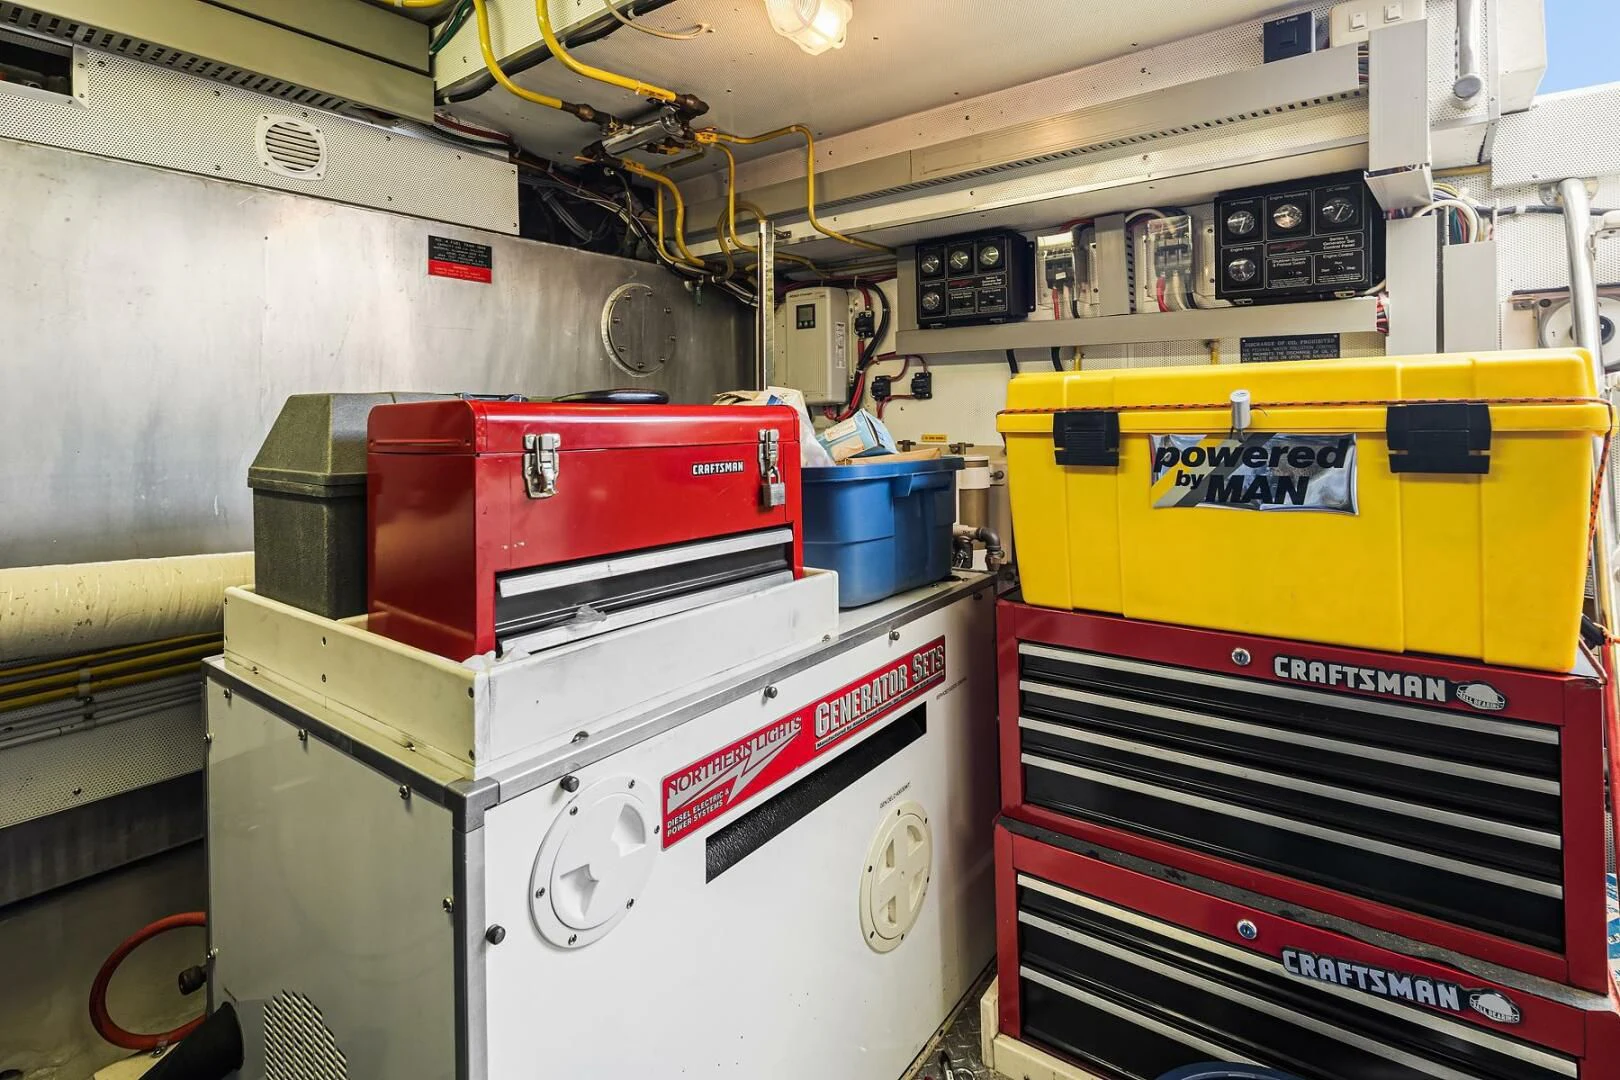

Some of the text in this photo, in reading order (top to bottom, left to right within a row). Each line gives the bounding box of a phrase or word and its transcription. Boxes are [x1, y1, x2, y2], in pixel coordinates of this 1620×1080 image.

[692, 461, 744, 476] CRAFTSMAN
[1153, 438, 1350, 473] powered
[1175, 470, 1312, 505] by MAN
[815, 664, 908, 739] GENERATOR
[911, 645, 944, 683] SETS
[1274, 656, 1446, 702] CRAFTSMAN
[667, 715, 803, 799] NORTHERN LIGHTS
[667, 811, 690, 829] DIESEL
[692, 791, 724, 814] ELECTRIC
[667, 800, 723, 838] POWER SYSTEMS
[1282, 950, 1460, 1011] CRAFTSMAN
